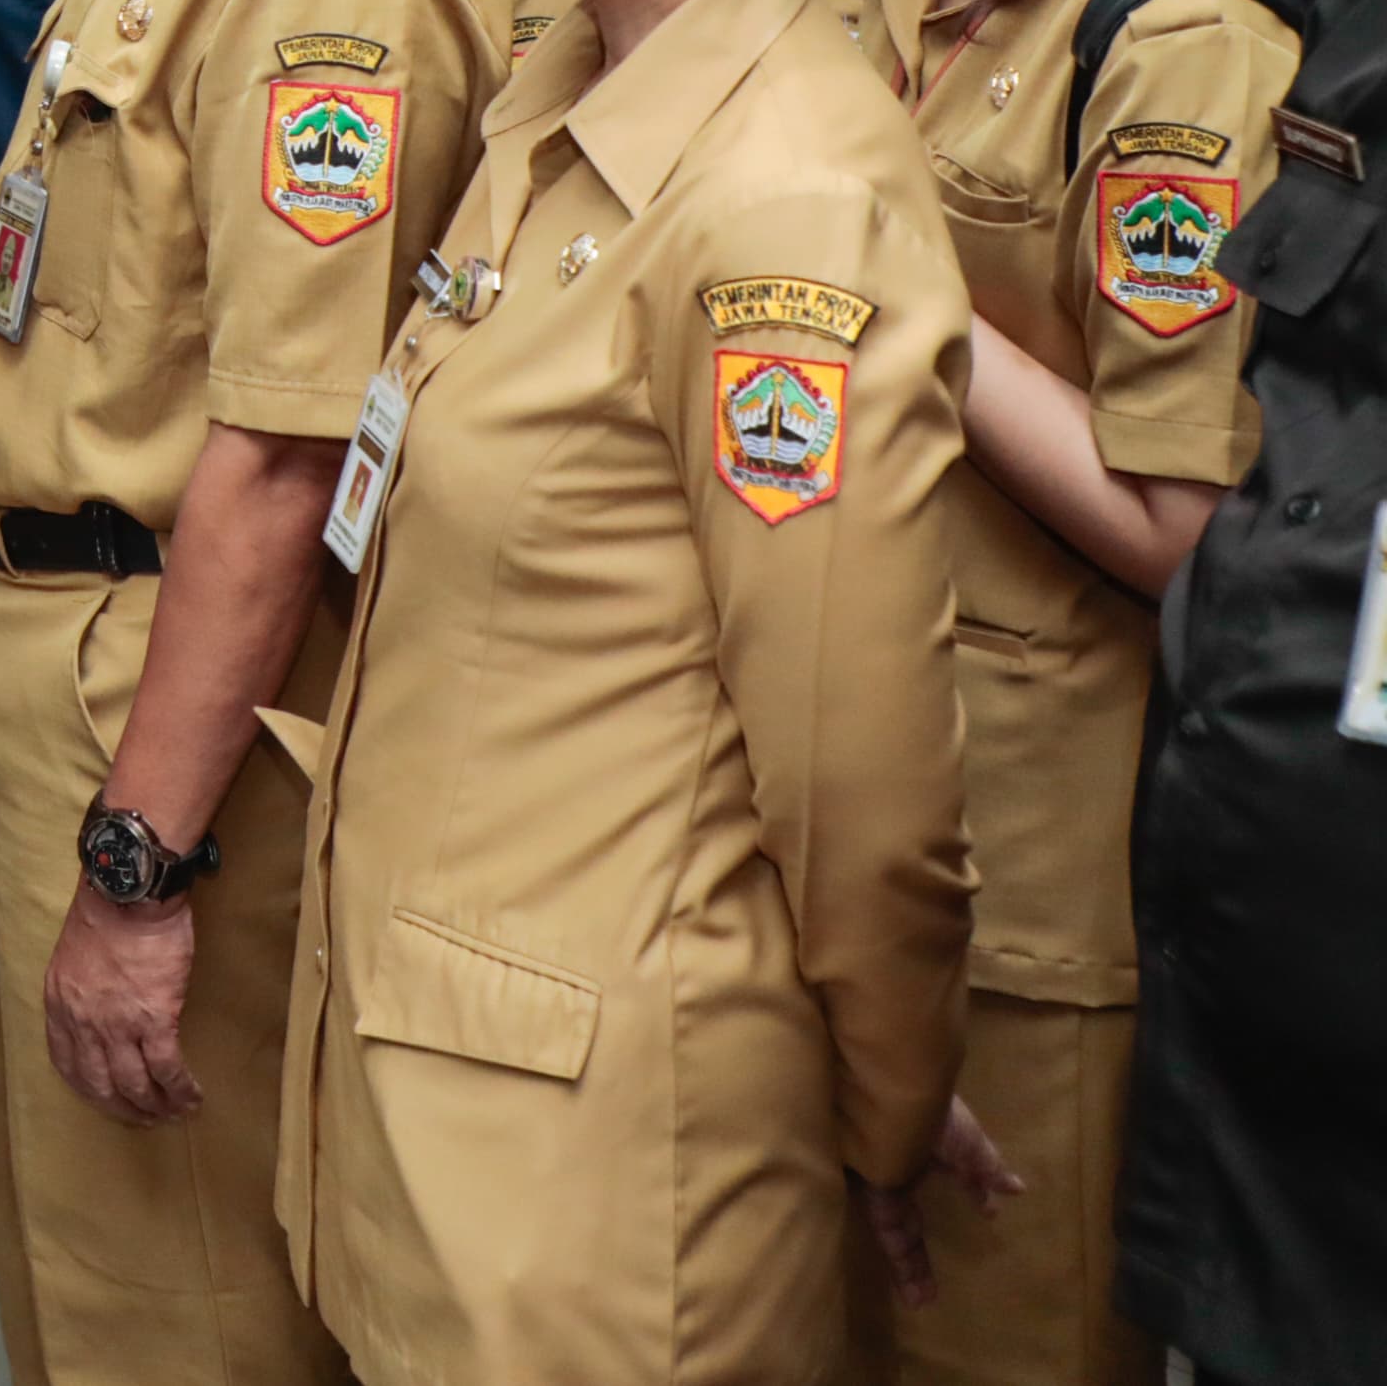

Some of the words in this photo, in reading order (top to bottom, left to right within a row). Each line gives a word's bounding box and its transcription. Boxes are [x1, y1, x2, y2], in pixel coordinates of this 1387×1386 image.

[282, 37, 346, 56] PEMERINTAH
[296, 50, 324, 63] JAWA
[326, 50, 366, 65] TENGAH
[1115, 125, 1184, 143] PEMERINTAH
[1129, 138, 1161, 152] JAWA
[1162, 138, 1208, 156] TENGAH
[708, 281, 807, 308] PEMERINTAH
[721, 304, 769, 325] JAWA
[779, 304, 852, 332] TENGAH
